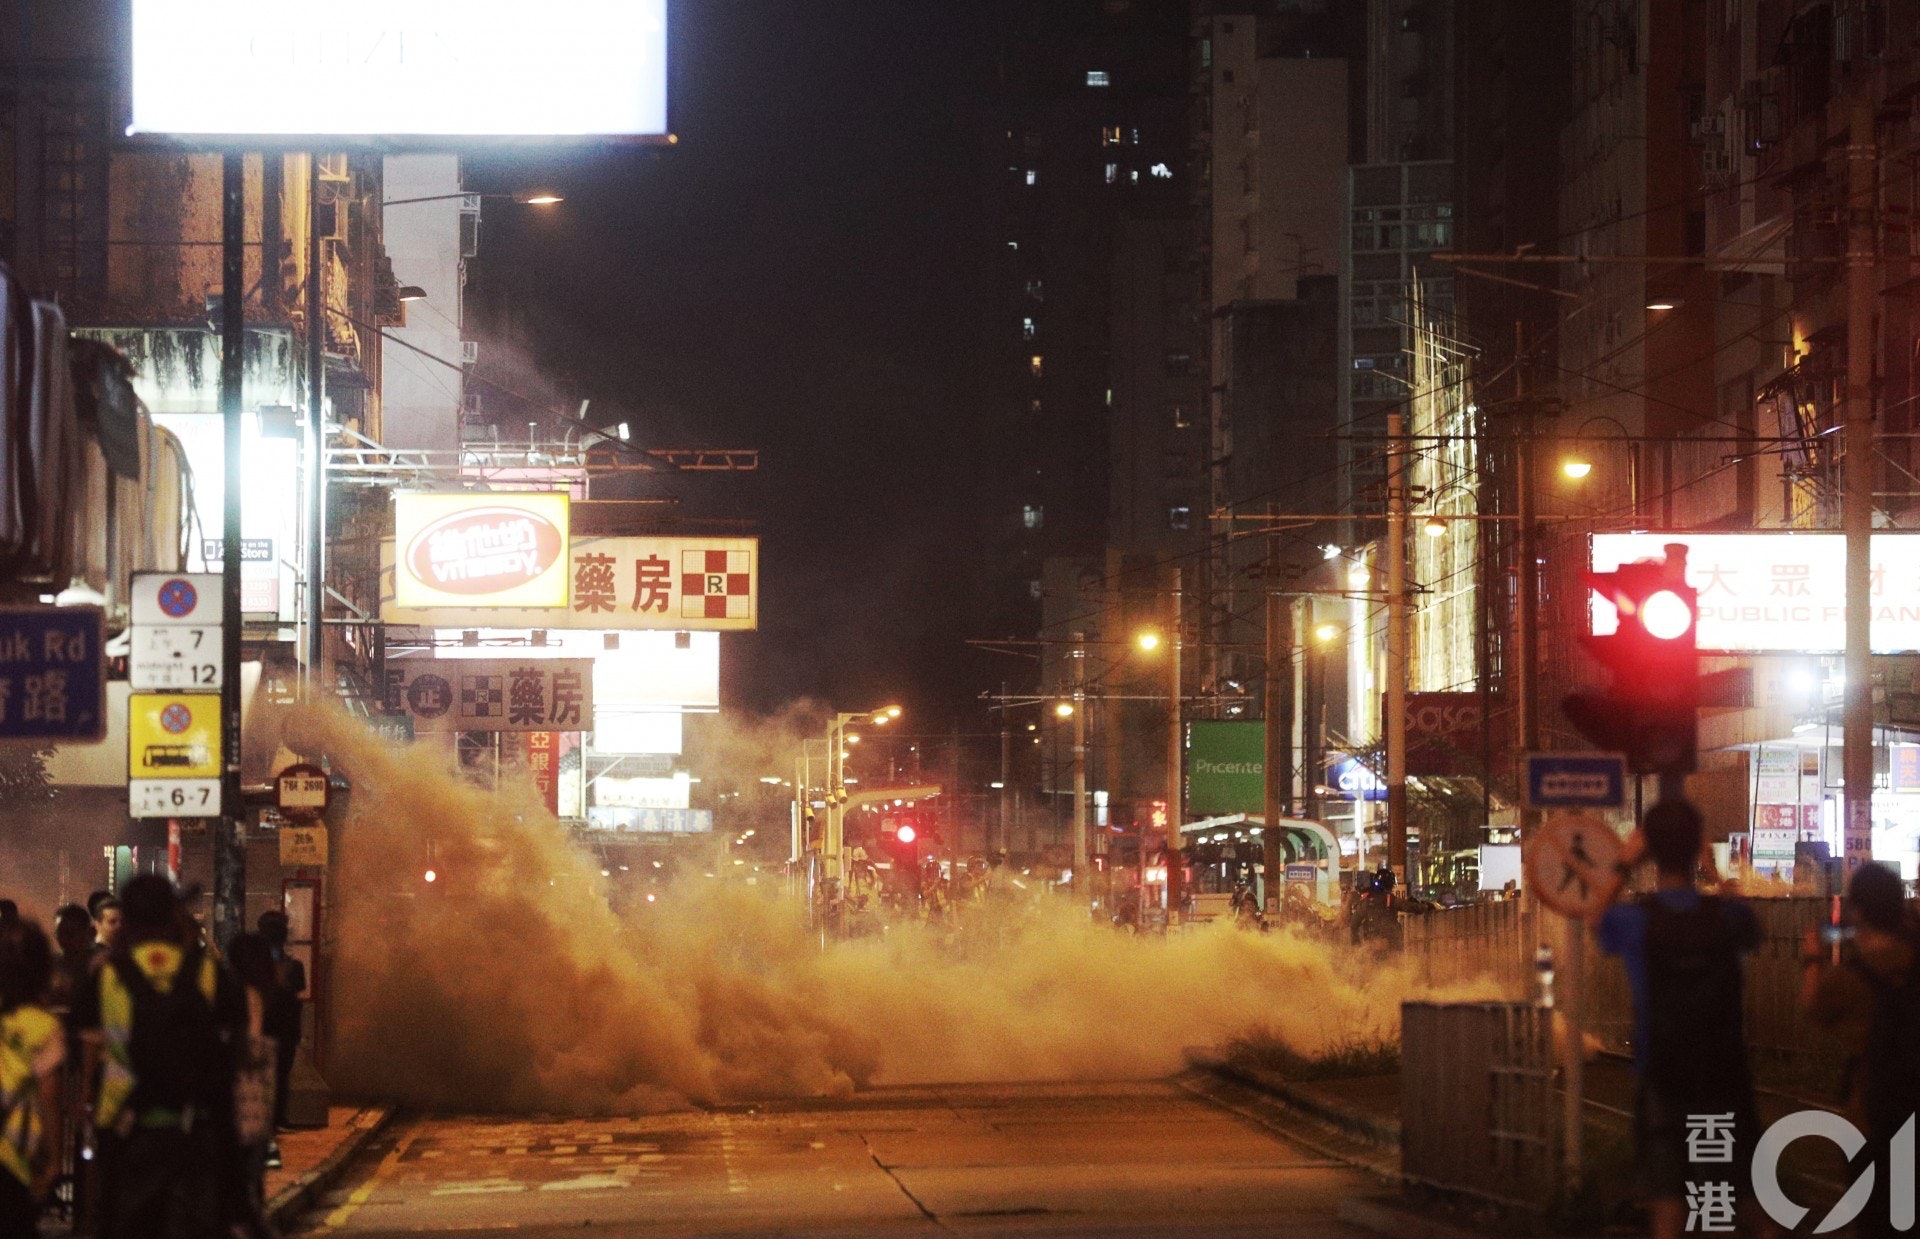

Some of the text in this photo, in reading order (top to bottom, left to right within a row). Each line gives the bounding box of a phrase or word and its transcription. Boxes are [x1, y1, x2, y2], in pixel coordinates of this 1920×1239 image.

[573, 552, 672, 614] 藥房
[1697, 606, 1811, 622] PUBLIC
[44, 630, 85, 661] Rd
[190, 629, 204, 651] 7
[191, 663, 217, 684] 12
[509, 666, 583, 726] 藥房
